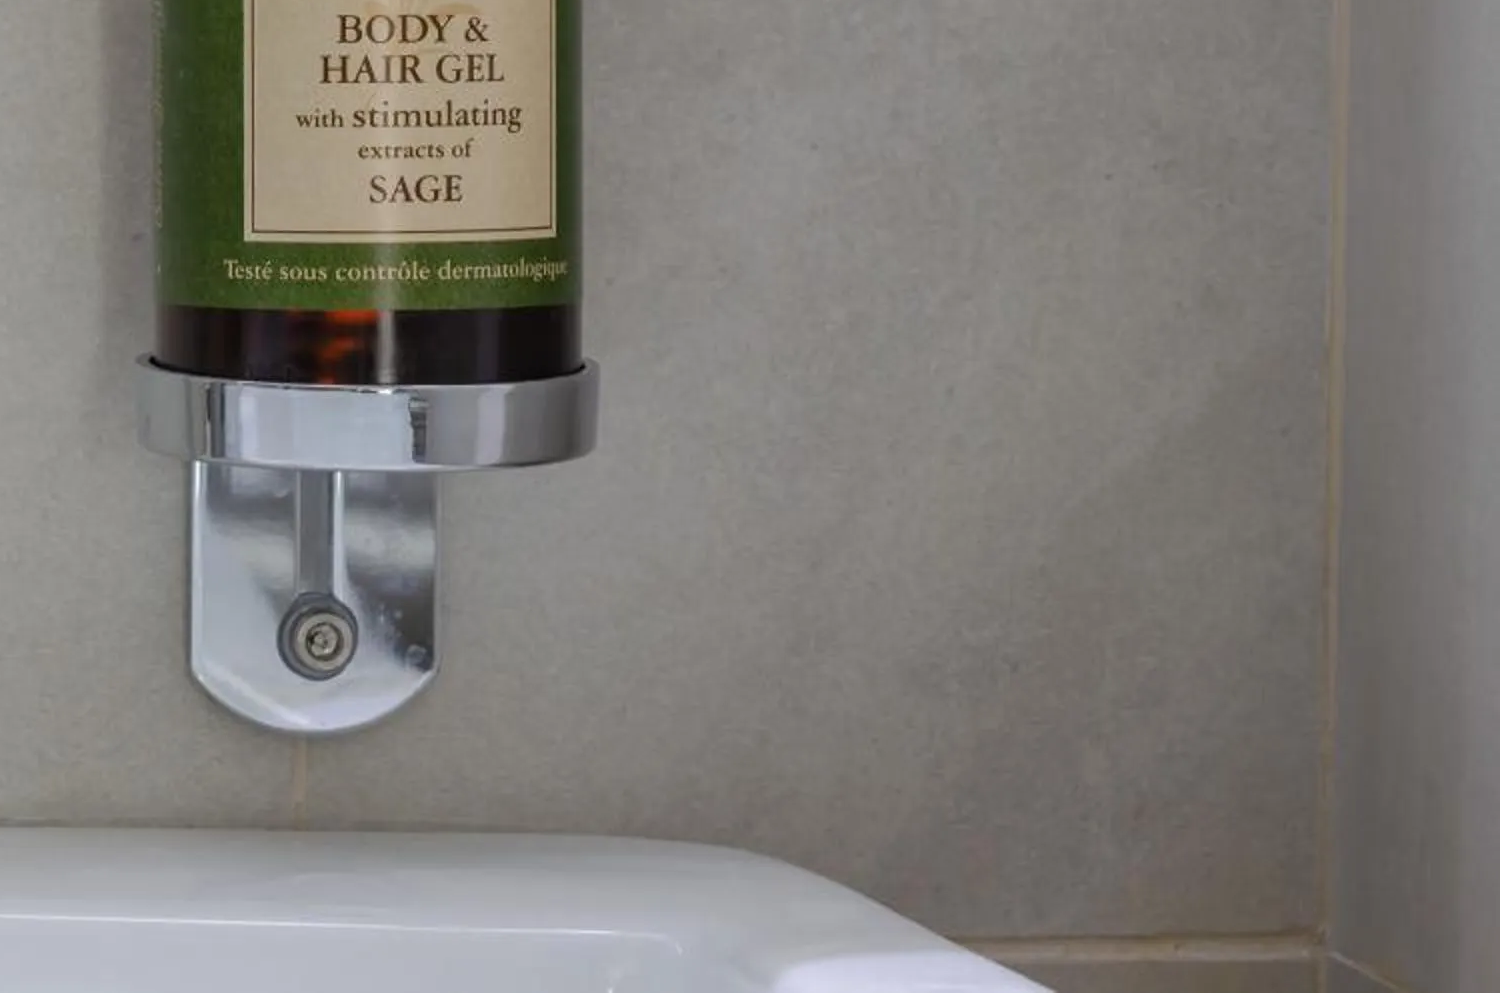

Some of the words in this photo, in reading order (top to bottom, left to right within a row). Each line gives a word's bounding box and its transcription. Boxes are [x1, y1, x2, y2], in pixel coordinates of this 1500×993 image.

[338, 14, 454, 44] BODY
[465, 15, 489, 43] &
[319, 54, 424, 84] HAIR
[435, 53, 505, 83] GEL
[296, 110, 344, 129] with
[352, 99, 522, 133] stimulating
[357, 144, 445, 159] extracts
[451, 138, 474, 158] of
[369, 175, 464, 203] SAGE
[223, 258, 272, 280] Testé
[279, 265, 328, 281] sous
[335, 257, 430, 282] contrôle
